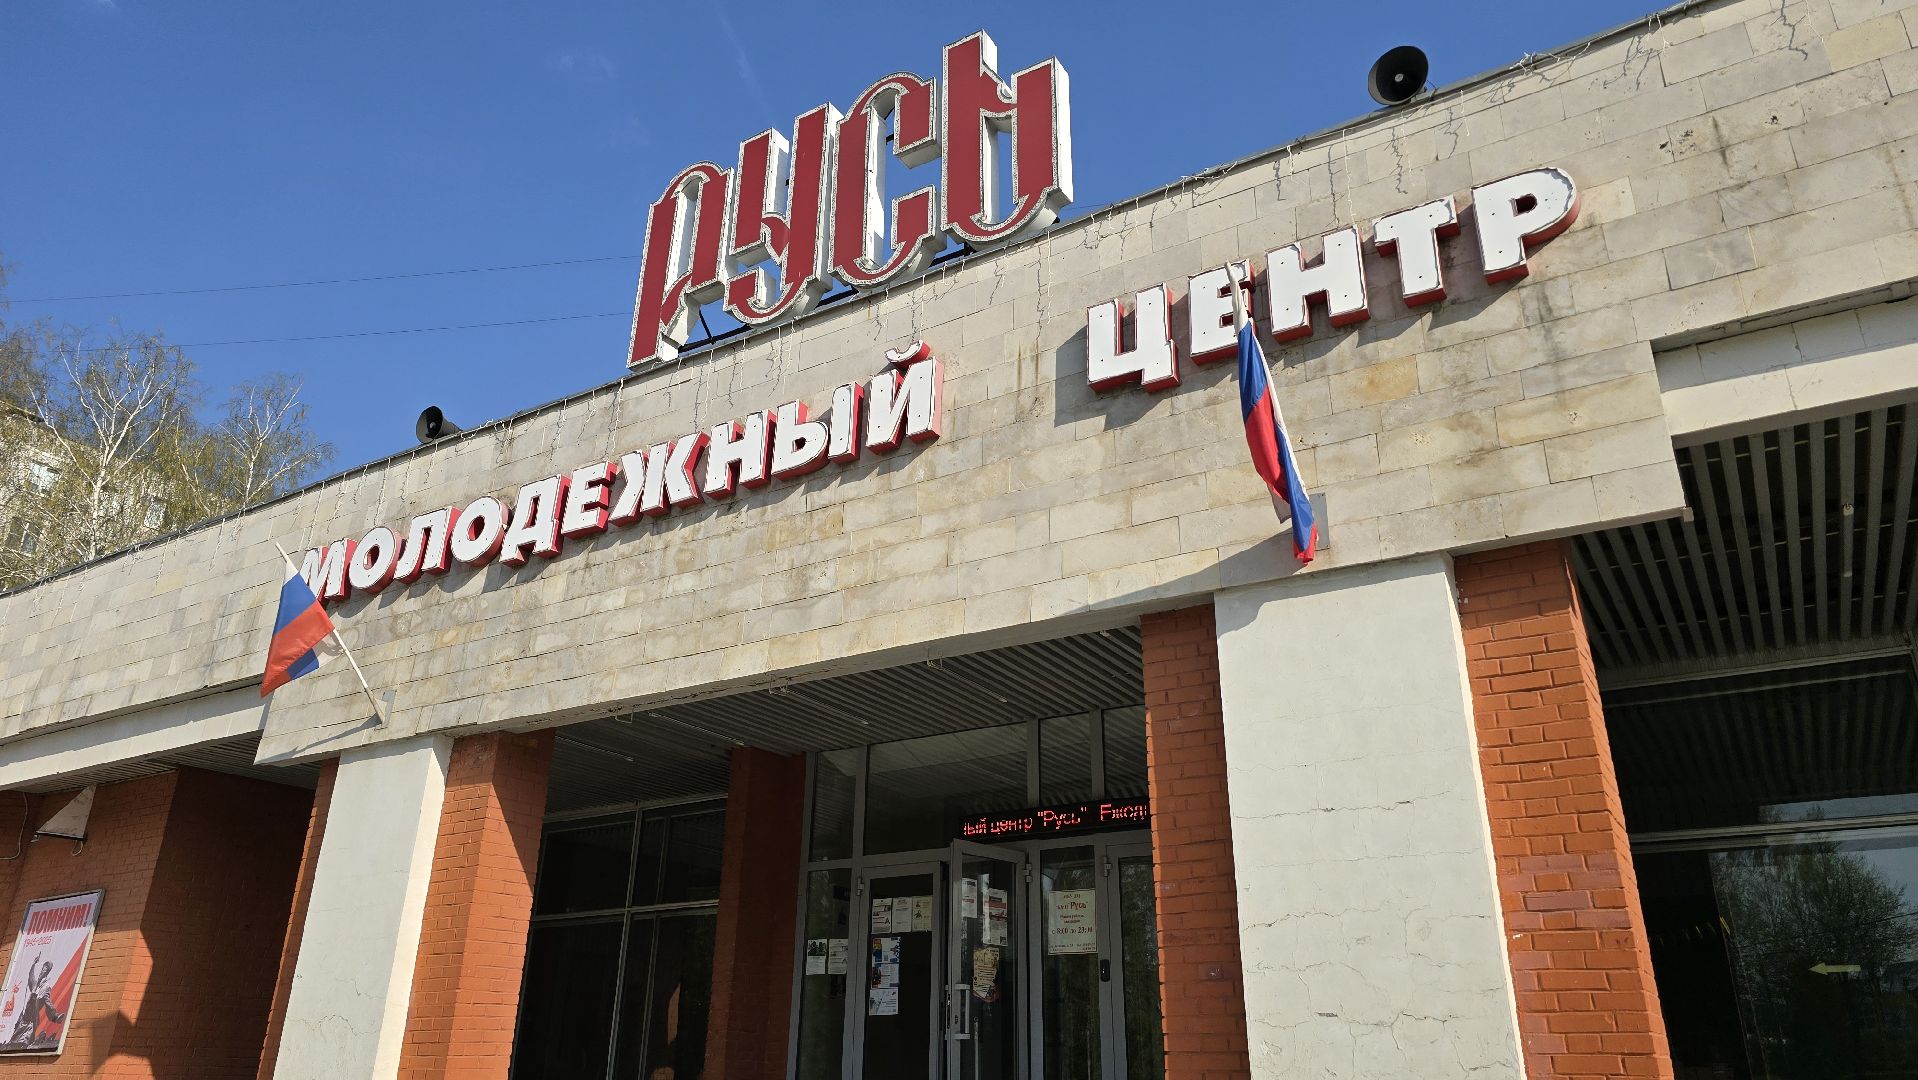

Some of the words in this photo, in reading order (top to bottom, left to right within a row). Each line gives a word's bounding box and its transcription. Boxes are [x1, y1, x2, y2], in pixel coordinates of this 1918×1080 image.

[626, 29, 1073, 372] РУСЬ
[299, 340, 943, 601] МОЛОДЕЖНЫЙ
[1087, 166, 1580, 393] ЦЕНТР
[990, 817, 1033, 834] центр
[1037, 806, 1087, 830] "Русь"
[26, 902, 93, 936] ПОМНИМ!
